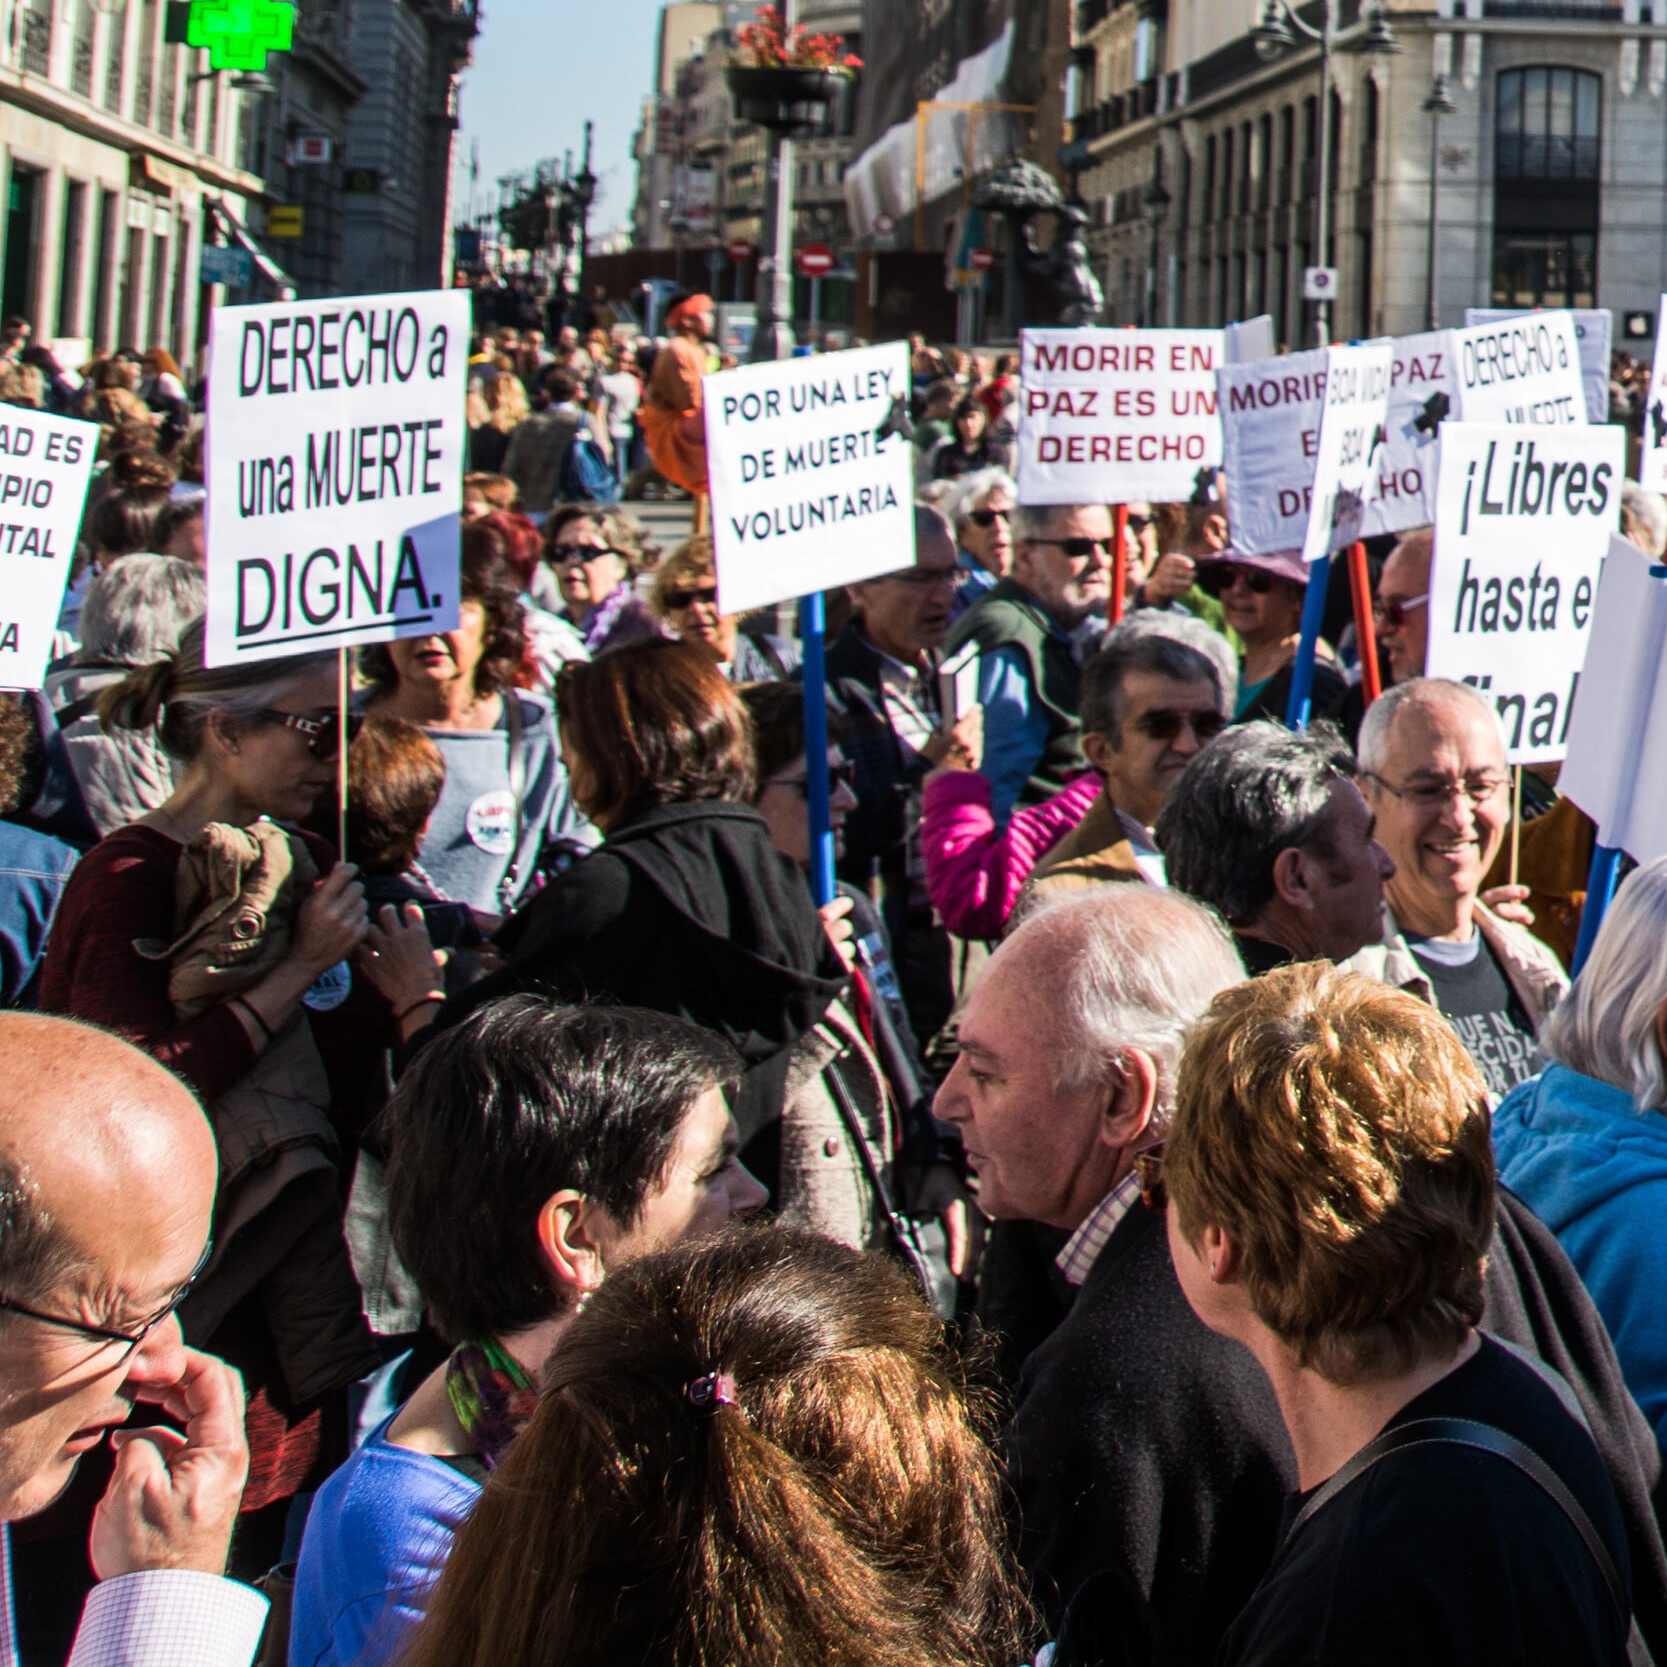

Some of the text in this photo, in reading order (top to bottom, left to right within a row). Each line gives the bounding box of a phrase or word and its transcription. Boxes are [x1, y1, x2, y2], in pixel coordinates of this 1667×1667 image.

[240, 308, 448, 397] DERECHO a
[1033, 345, 1215, 372] MORIR EN
[1391, 354, 1445, 386] PAZ
[1463, 324, 1568, 388] DERECHO a
[724, 367, 894, 426] POR UNA LEY
[1027, 391, 1218, 418] PAZ ES UN
[45, 432, 83, 464] ES
[741, 431, 889, 483] DE MUERTE
[1038, 435, 1205, 464] DERECHO
[1302, 429, 1318, 457] E
[239, 419, 443, 519] una MUERTE
[1278, 469, 1422, 517] DEHO
[1460, 441, 1613, 536] ¡Libres
[732, 483, 899, 543] VOLUNTARIA
[236, 535, 442, 636] DIGNA.
[1454, 559, 1600, 633] hasta e
[0, 622, 19, 653] A
[1460, 671, 1581, 749] nal
[1490, 1011, 1520, 1035] N
[1467, 1034, 1537, 1065] ECIDA
[1483, 1065, 1508, 1092] OR
